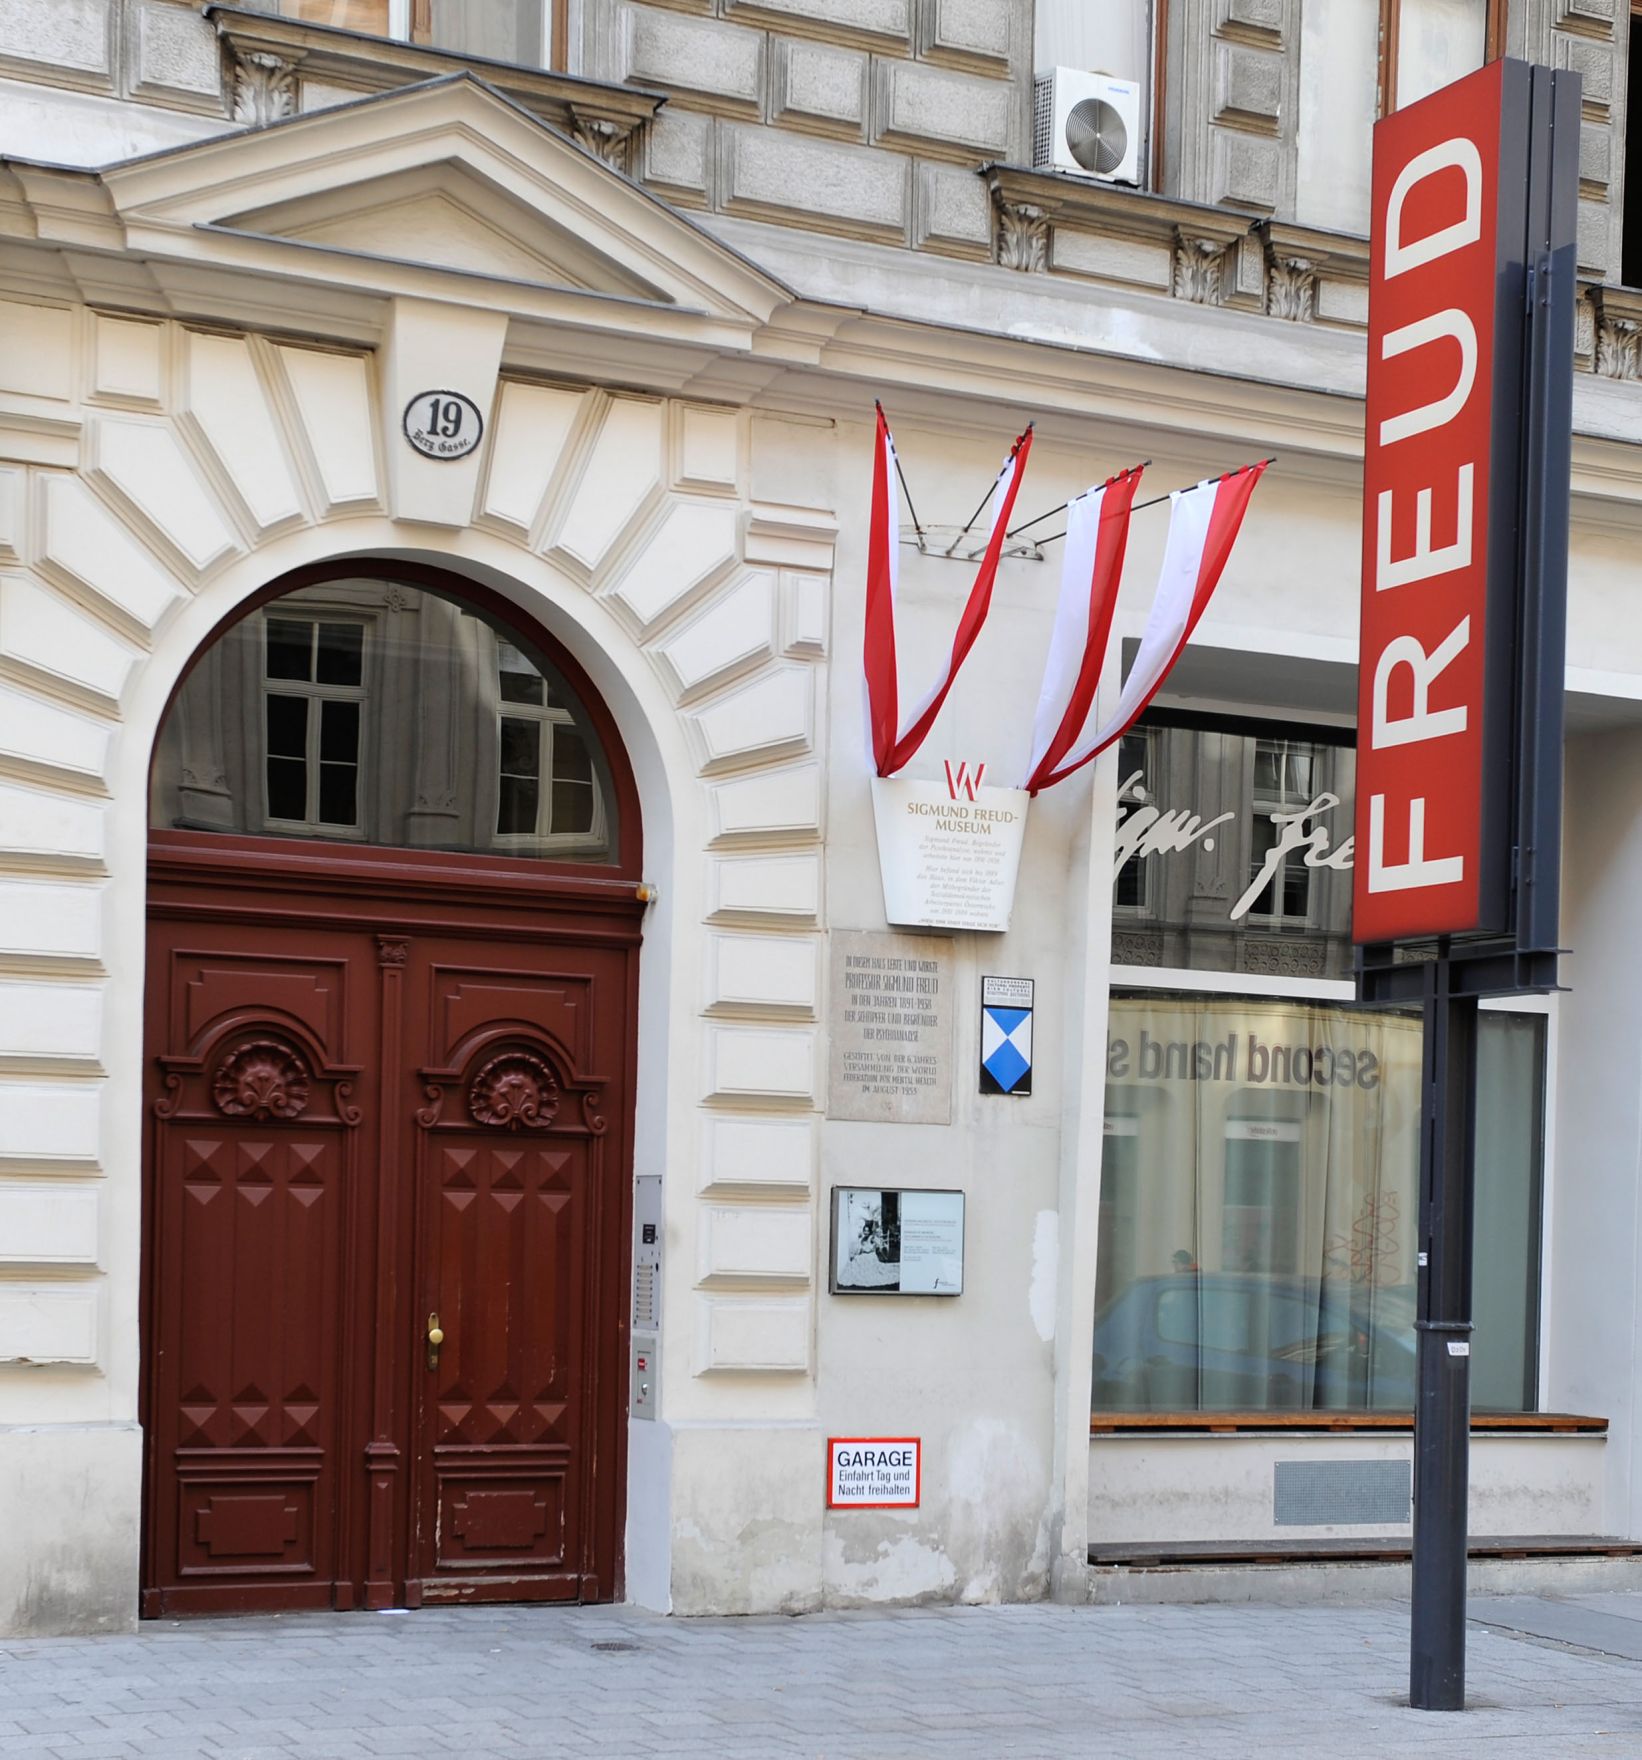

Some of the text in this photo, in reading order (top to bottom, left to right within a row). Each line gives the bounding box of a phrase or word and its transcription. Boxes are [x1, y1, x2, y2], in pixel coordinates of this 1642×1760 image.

[426, 398, 463, 438] 19
[1368, 138, 1483, 894] FREUD
[907, 802, 1019, 824] SIGMUND FREUD-
[935, 819, 991, 835] MUSEUM
[1230, 792, 1354, 920] Fre
[852, 956, 871, 969] DIESEM
[871, 957, 886, 970] HAUS
[887, 958, 902, 971] LEBTE
[845, 972, 938, 994] PROFESSOR SIGMUND FREUD
[851, 994, 858, 1006] IN
[858, 994, 871, 1007] DEN
[873, 995, 897, 1008] JAHREN
[844, 1010, 855, 1022] DER
[863, 1028, 875, 1040] DER
[911, 1065, 937, 1076] WORLD
[872, 1085, 898, 1096] AUGUST
[837, 1451, 912, 1467] GARAGE
[839, 1469, 910, 1483] Einfahrt Tag und
[838, 1484, 910, 1496] Nacht freihalten
